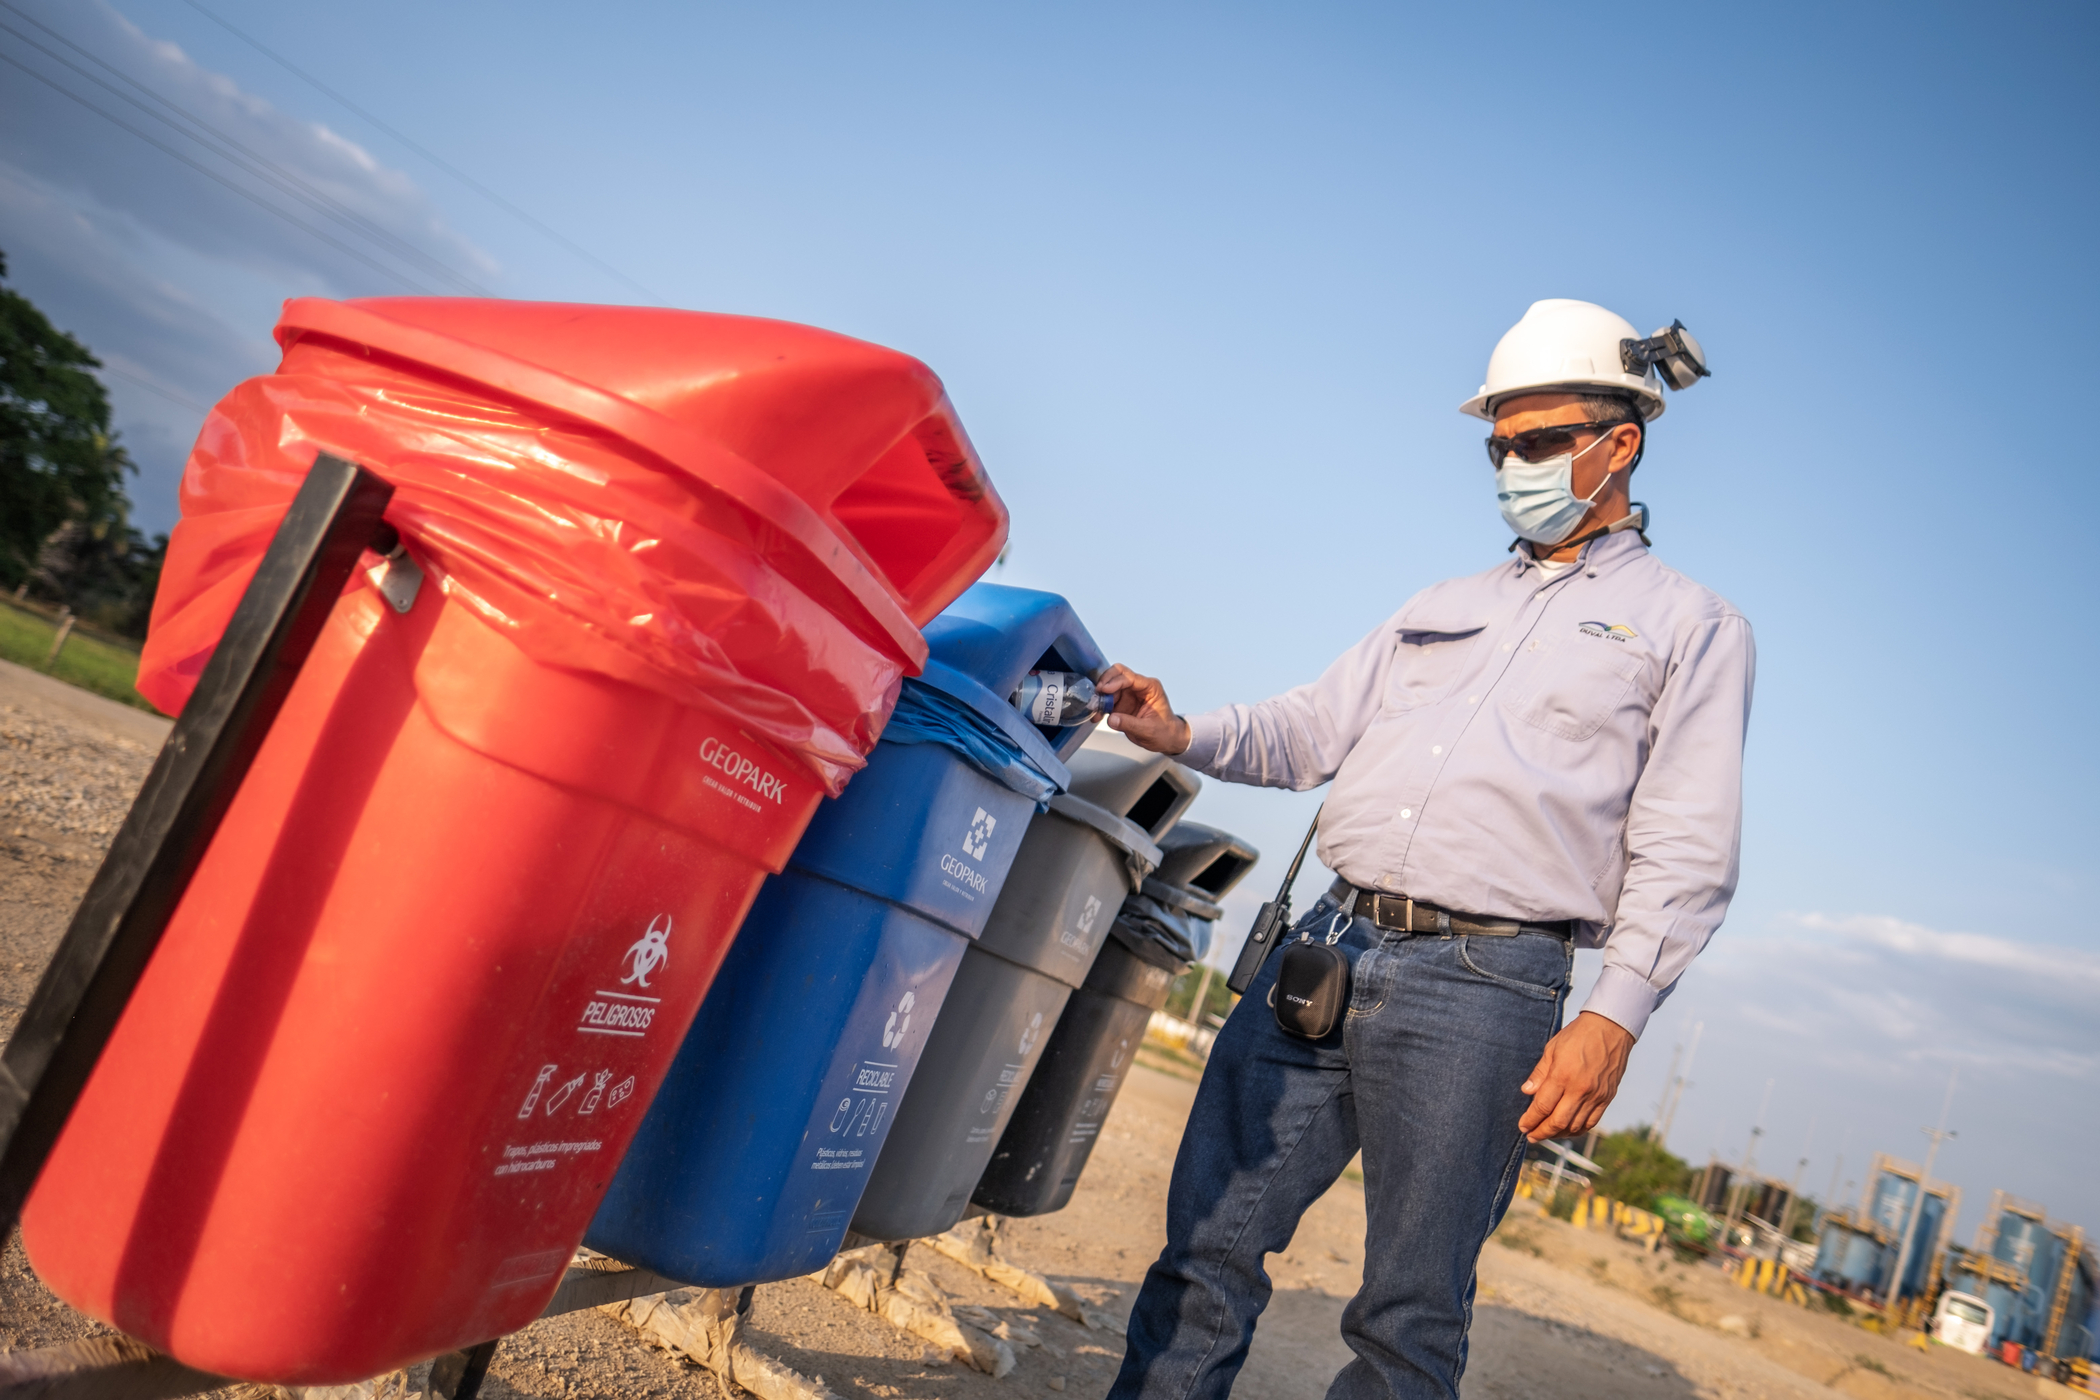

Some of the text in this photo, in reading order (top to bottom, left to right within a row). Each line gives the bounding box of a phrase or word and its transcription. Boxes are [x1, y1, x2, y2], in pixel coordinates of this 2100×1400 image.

[699, 736, 788, 805] GEOPARK
[940, 853, 989, 895] GEOPARK
[1286, 994, 1313, 1007] SONY
[581, 1001, 656, 1029] PELIGROSOS
[855, 1069, 895, 1087] RECICLABLE
